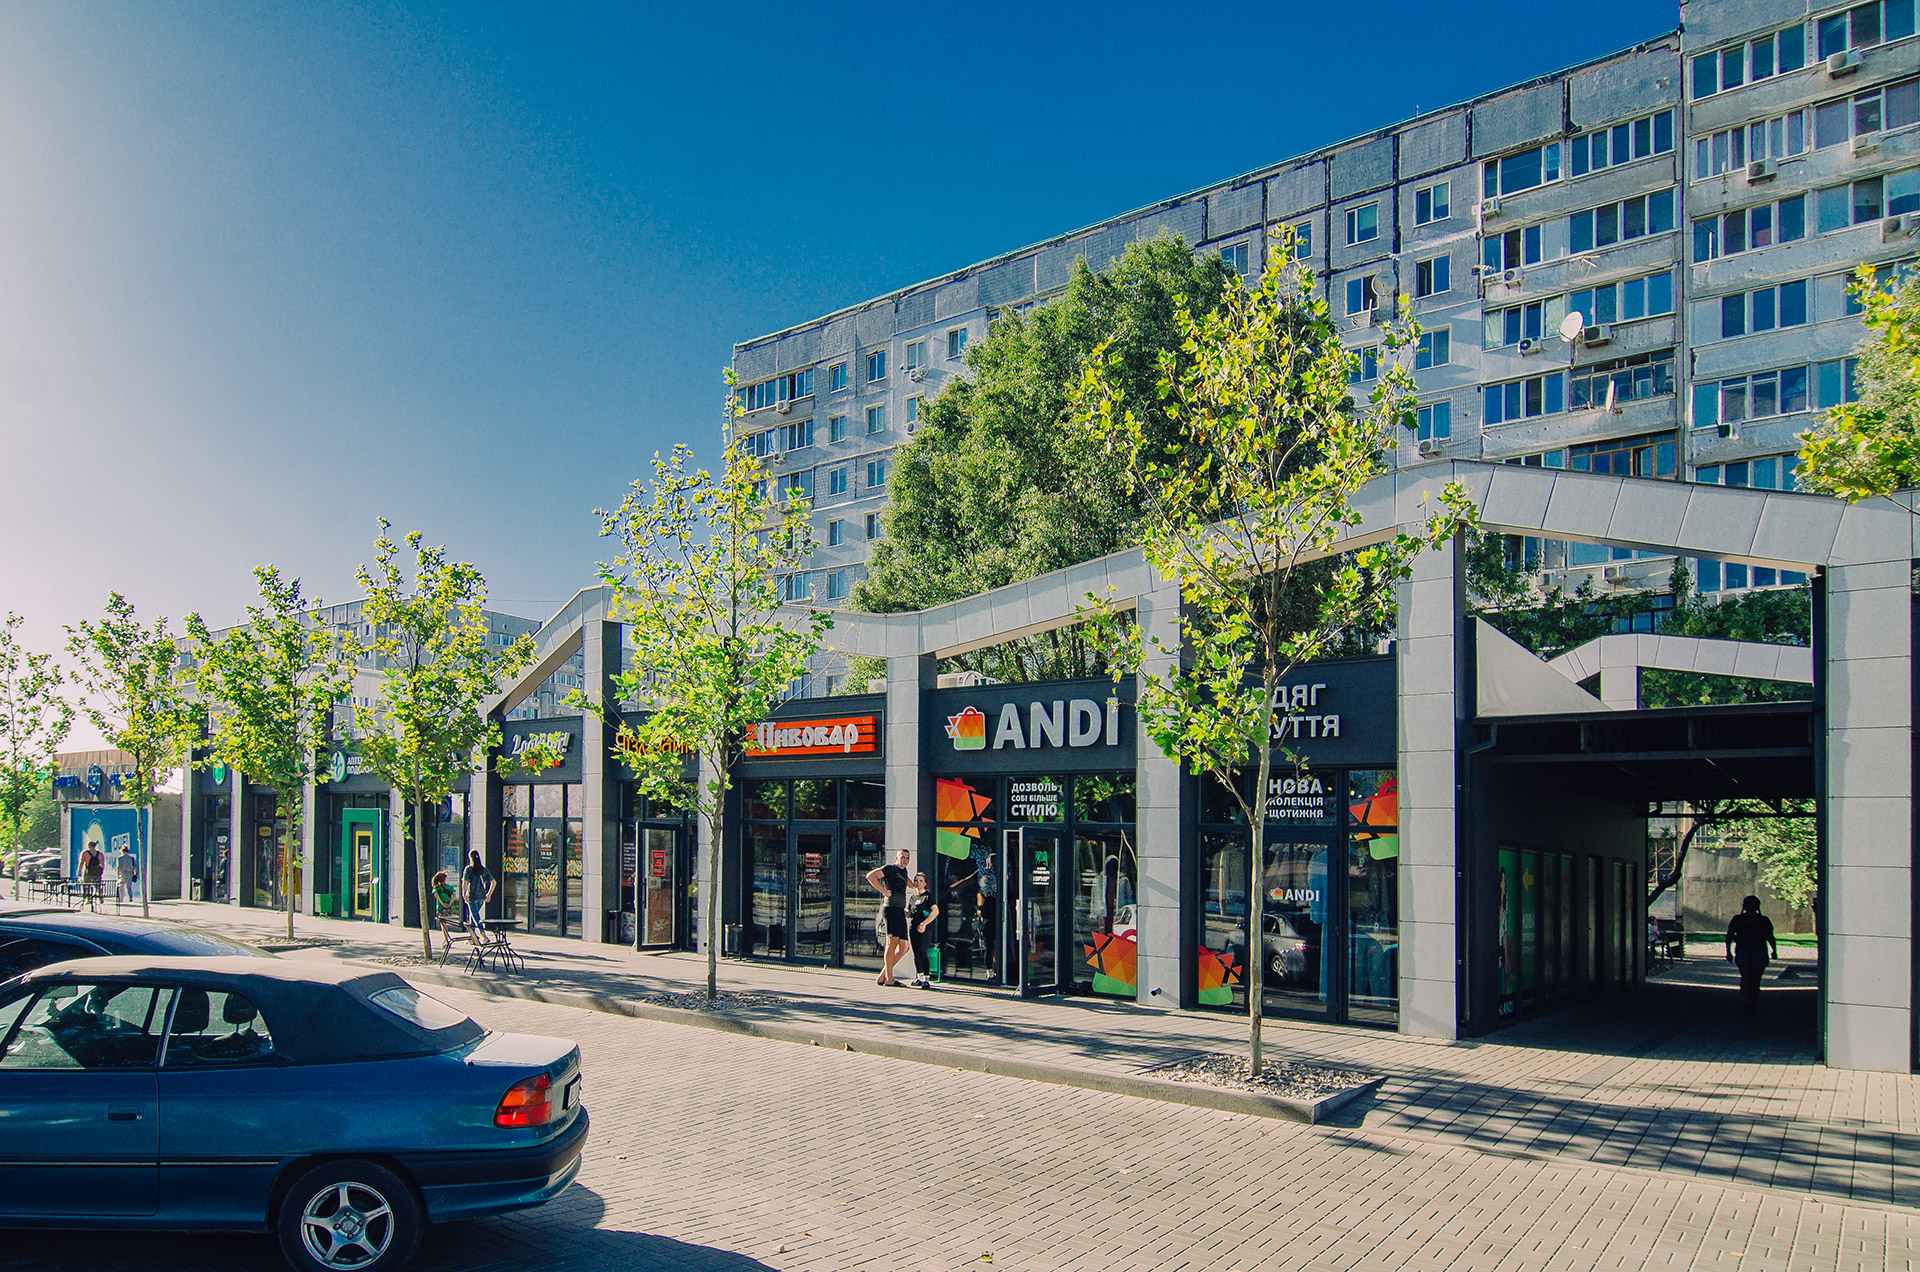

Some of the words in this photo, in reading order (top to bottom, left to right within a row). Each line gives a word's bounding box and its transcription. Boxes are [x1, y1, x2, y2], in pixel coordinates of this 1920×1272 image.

[993, 697, 1119, 749] ANDI
[757, 723, 859, 753] Пивовар
[1011, 782, 1058, 794] ДОЗВОЛЬ
[1269, 778, 1324, 794] НОВА
[1011, 794, 1028, 802] СОБІ
[1029, 794, 1058, 802] БІЛЬШЕ
[1269, 797, 1324, 807] КОЛЕКЦІЯ
[1011, 804, 1058, 816] СТИЛЮ
[1269, 809, 1324, 819] ЩОТИЖНЯ
[1284, 889, 1320, 902] ANDI
